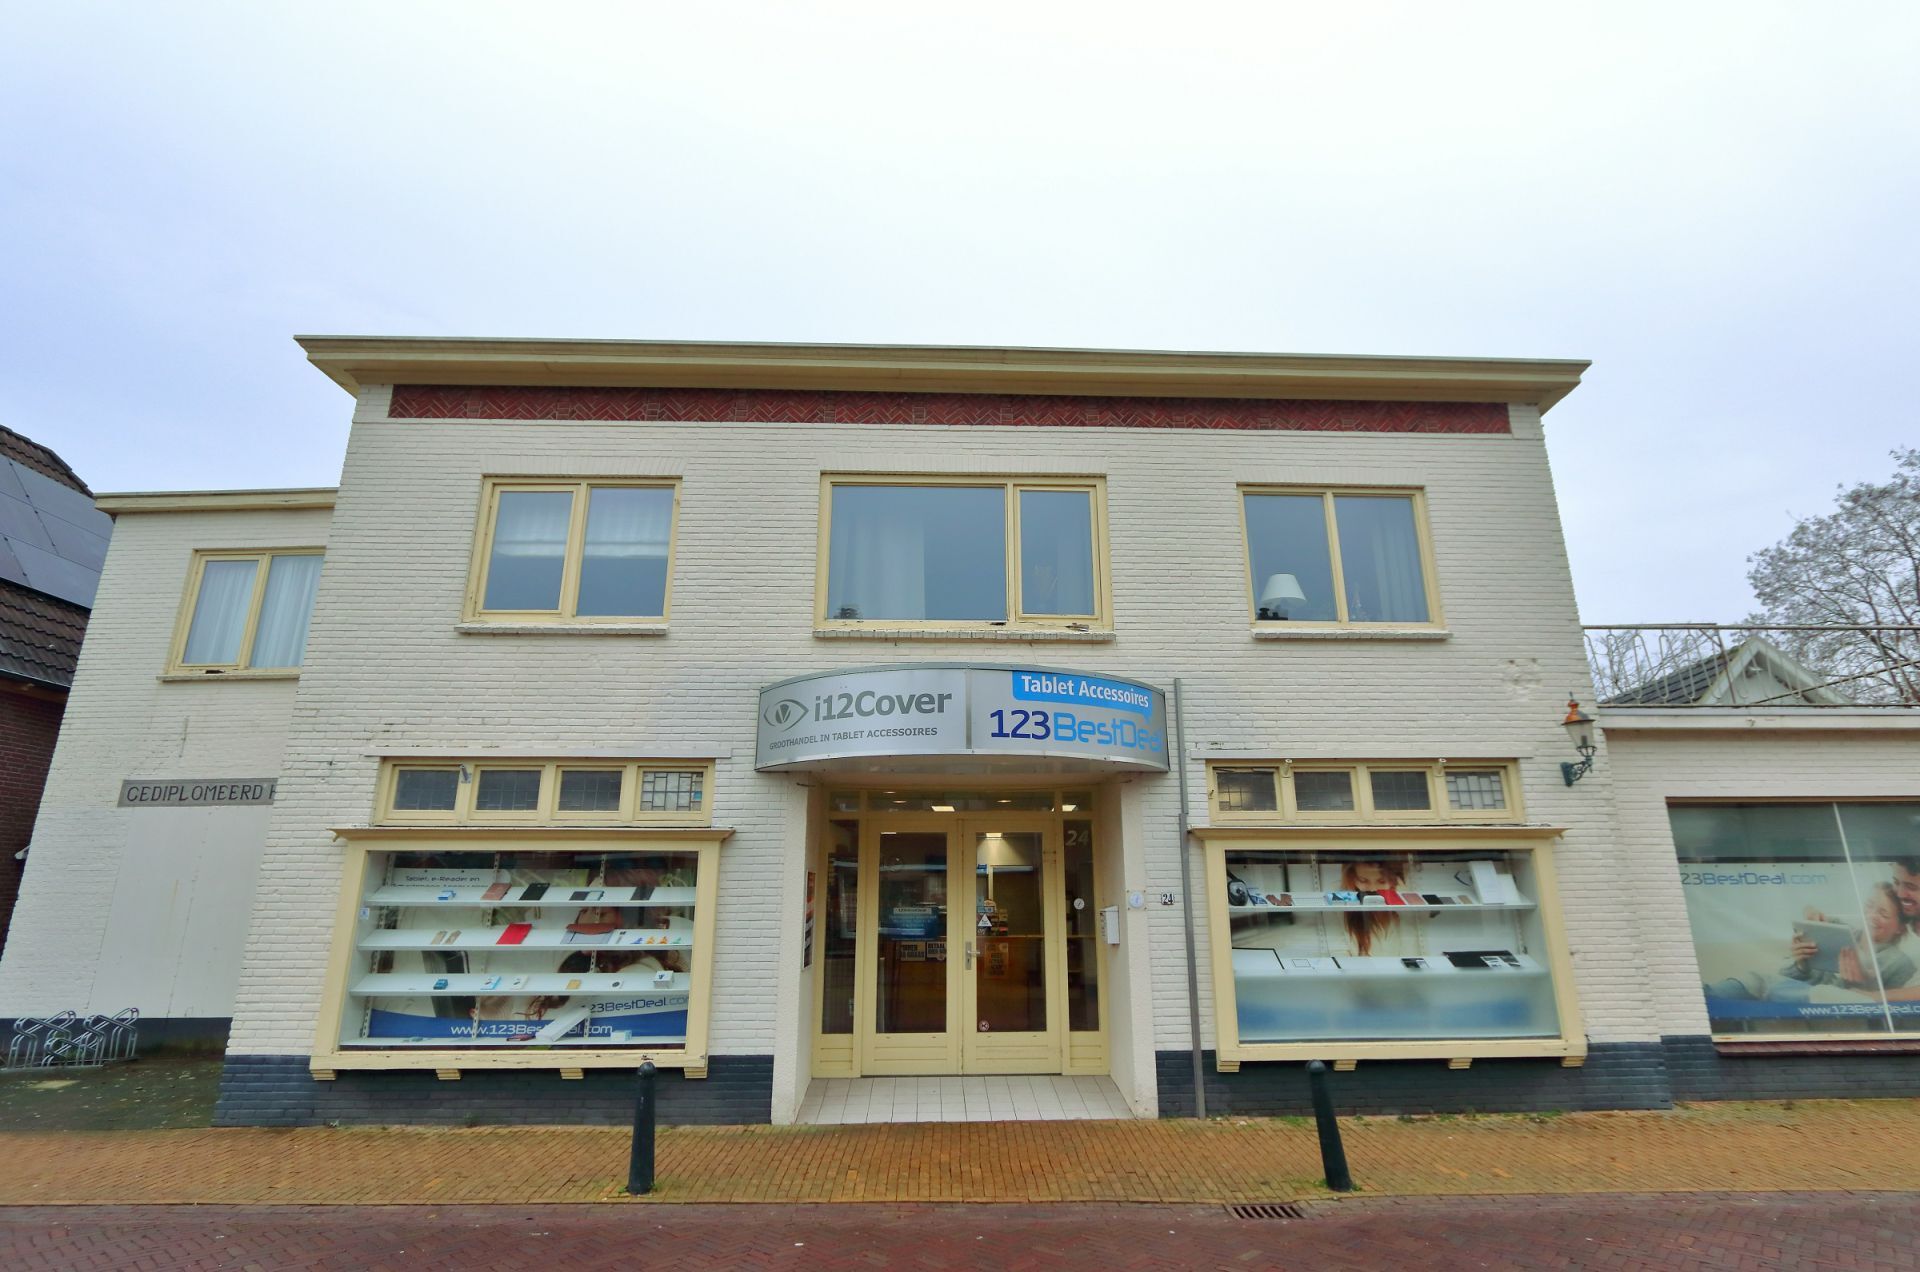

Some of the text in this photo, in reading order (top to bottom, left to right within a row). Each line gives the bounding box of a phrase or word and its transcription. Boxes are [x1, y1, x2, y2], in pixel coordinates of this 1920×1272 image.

[1021, 675, 1150, 708] Tablet Accessoires
[813, 690, 953, 722] i12Cover
[769, 727, 938, 750] GROOTHANDEL IN TABLET ACCESSOIRES
[1065, 830, 1090, 846] 24
[1680, 872, 1828, 886] 23BestDeal.com
[1162, 893, 1174, 905] 24
